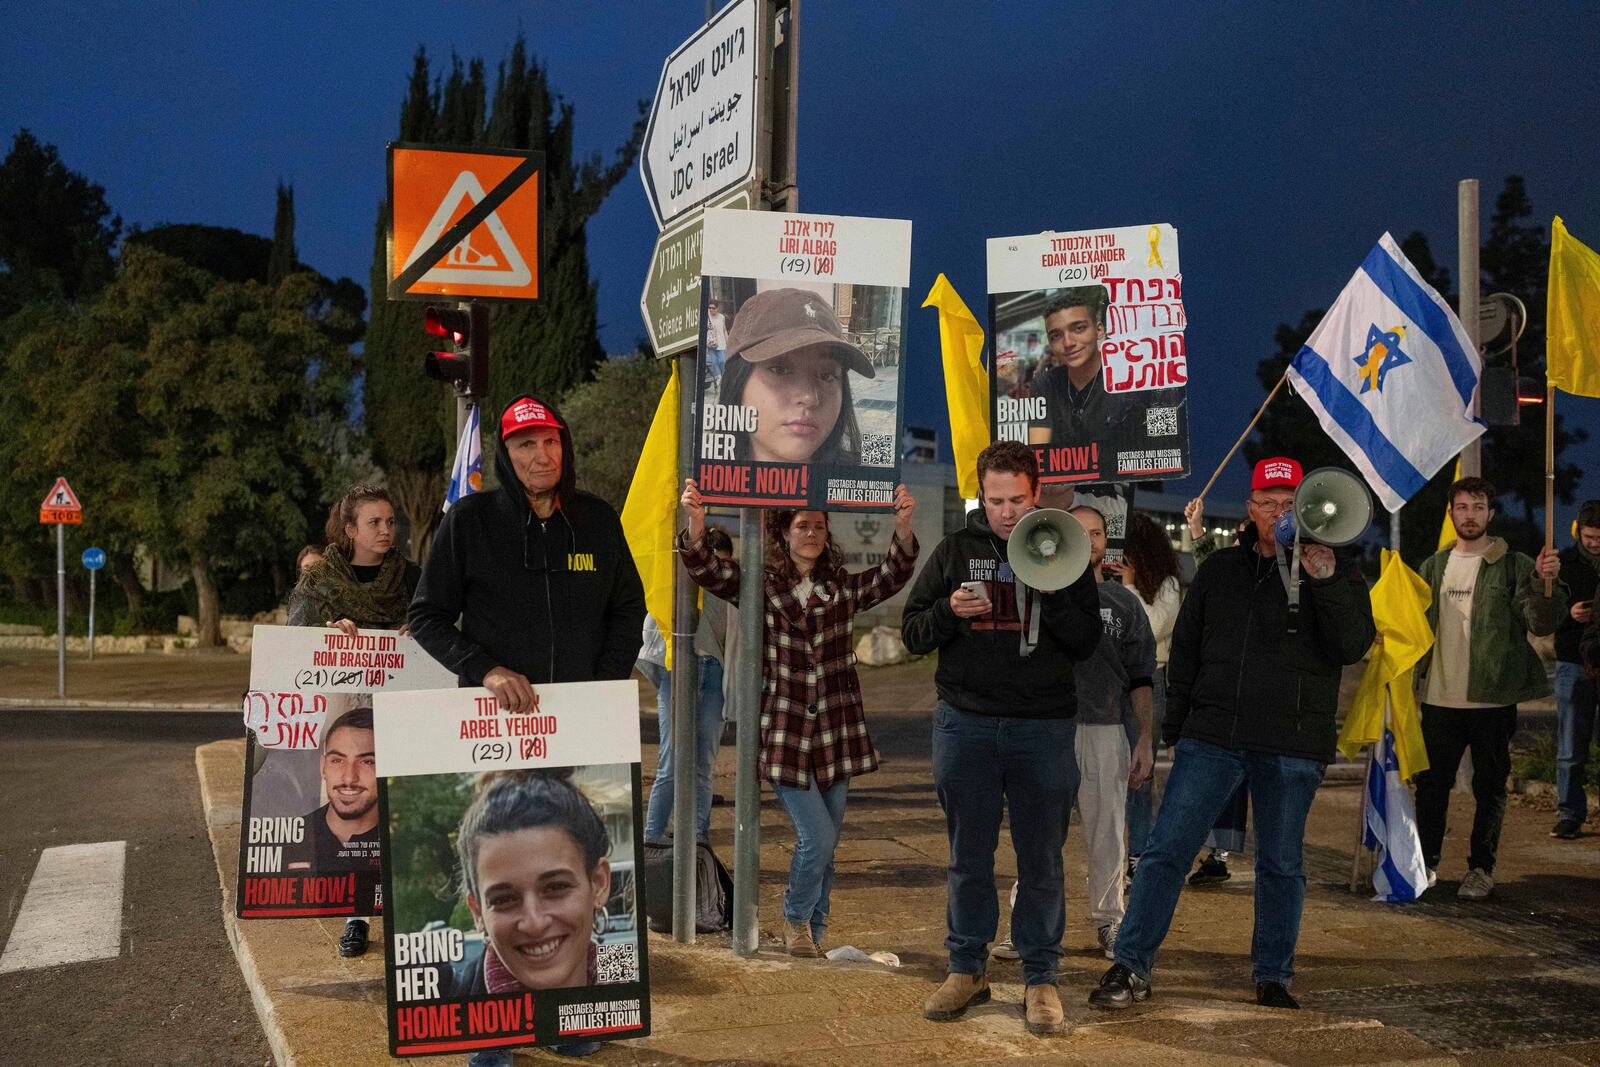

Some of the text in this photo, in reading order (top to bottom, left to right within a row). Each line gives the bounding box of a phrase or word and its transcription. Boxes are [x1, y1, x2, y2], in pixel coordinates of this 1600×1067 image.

[669, 58, 705, 110] ישראל
[708, 92, 742, 124] جوينت
[670, 131, 739, 200] JDC Israel
[783, 220, 835, 238] לירי אלבג
[779, 237, 837, 256] LIRI ALBAG
[1050, 234, 1116, 252] עידן אלכסנדר
[660, 241, 682, 279] המדע
[780, 257, 811, 275] (19)
[1042, 248, 1126, 267] EDAN ALEXANDER
[1058, 267, 1088, 283] (20)
[662, 278, 682, 310] العلوم
[1101, 277, 1181, 303] הפחד
[659, 315, 682, 339] Science
[1102, 333, 1185, 366] הורגים
[1105, 361, 1188, 392] אותנו
[515, 412, 546, 422] WAR
[703, 404, 758, 433] BRING
[997, 396, 1047, 422] BRING
[997, 422, 1029, 446] HIM
[701, 433, 736, 460] HER
[1050, 442, 1099, 472] NOW!
[1117, 449, 1181, 460] HOSTAGES AND MISSING
[1117, 457, 1182, 471] FAMILIES FORUM
[1265, 471, 1291, 479] WAR
[700, 464, 808, 496] HOME NOW!
[828, 479, 894, 491] HOSTAGES AND MISSING
[828, 489, 893, 503] FAMILIES FORUM
[969, 559, 996, 569] BRING
[970, 570, 993, 580] THEM
[324, 634, 396, 651] רום ברסלבסקי
[313, 651, 404, 669] ROM BRASLAVSKI
[294, 669, 328, 690] (21)
[247, 692, 327, 724] תחזירו
[474, 697, 498, 716] הוד
[259, 721, 318, 748] אותי
[460, 716, 557, 739] ARBEL YEHOUD
[472, 742, 512, 764] (29)
[248, 816, 305, 844] BRING
[246, 846, 283, 873] HIM
[244, 877, 298, 906] HOME
[302, 873, 355, 903] NOW!
[395, 929, 464, 966] BRING
[396, 967, 440, 1002] HER
[397, 993, 534, 1041] HOME NOW!
[558, 1000, 640, 1016] HOSTAGES AND MISSING
[558, 1010, 641, 1031] FAMILIES FORUM
